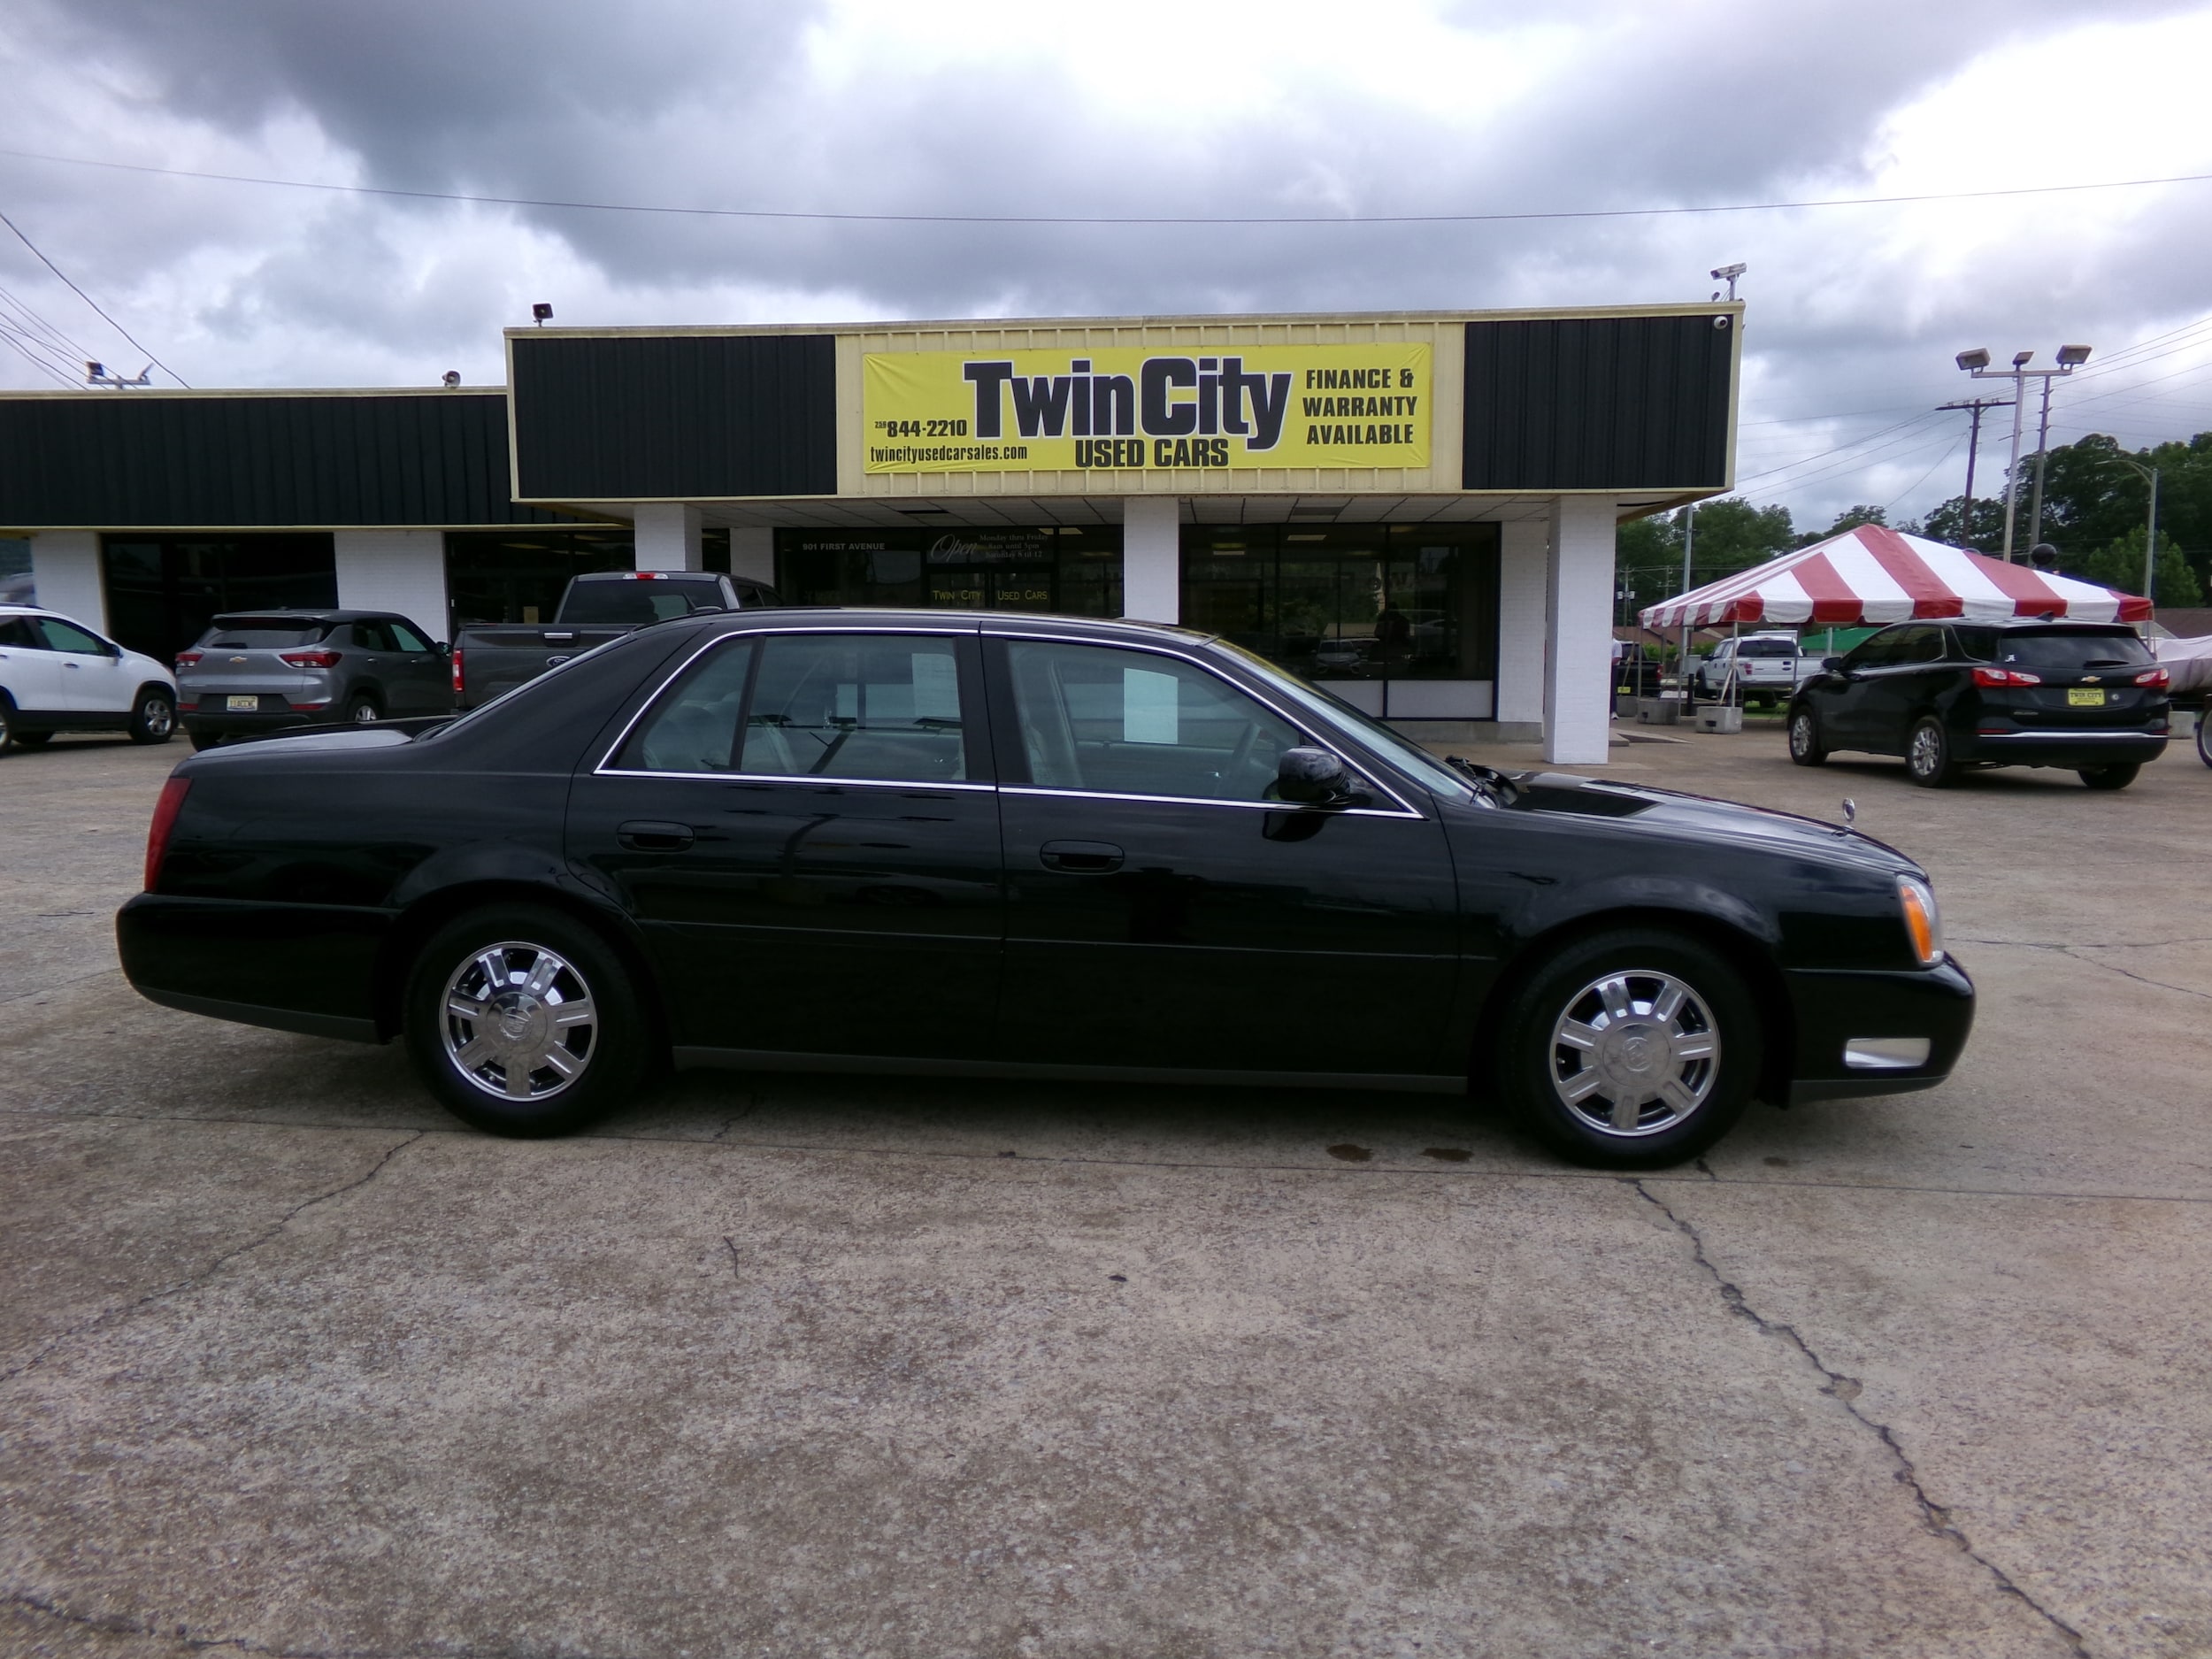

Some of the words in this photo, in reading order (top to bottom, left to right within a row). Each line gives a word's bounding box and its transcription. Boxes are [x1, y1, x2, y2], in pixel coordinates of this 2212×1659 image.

[1306, 369, 1392, 389] FINANCE
[1400, 368, 1413, 388] &
[1302, 396, 1417, 418] WARRANTY
[887, 419, 967, 437] 844-2210
[1307, 424, 1414, 445] AVAILABLE
[870, 445, 1027, 465] twincityusedcarsales.com
[1075, 439, 1145, 468] USED
[1154, 439, 1228, 467] CARS
[931, 534, 978, 563] Open
